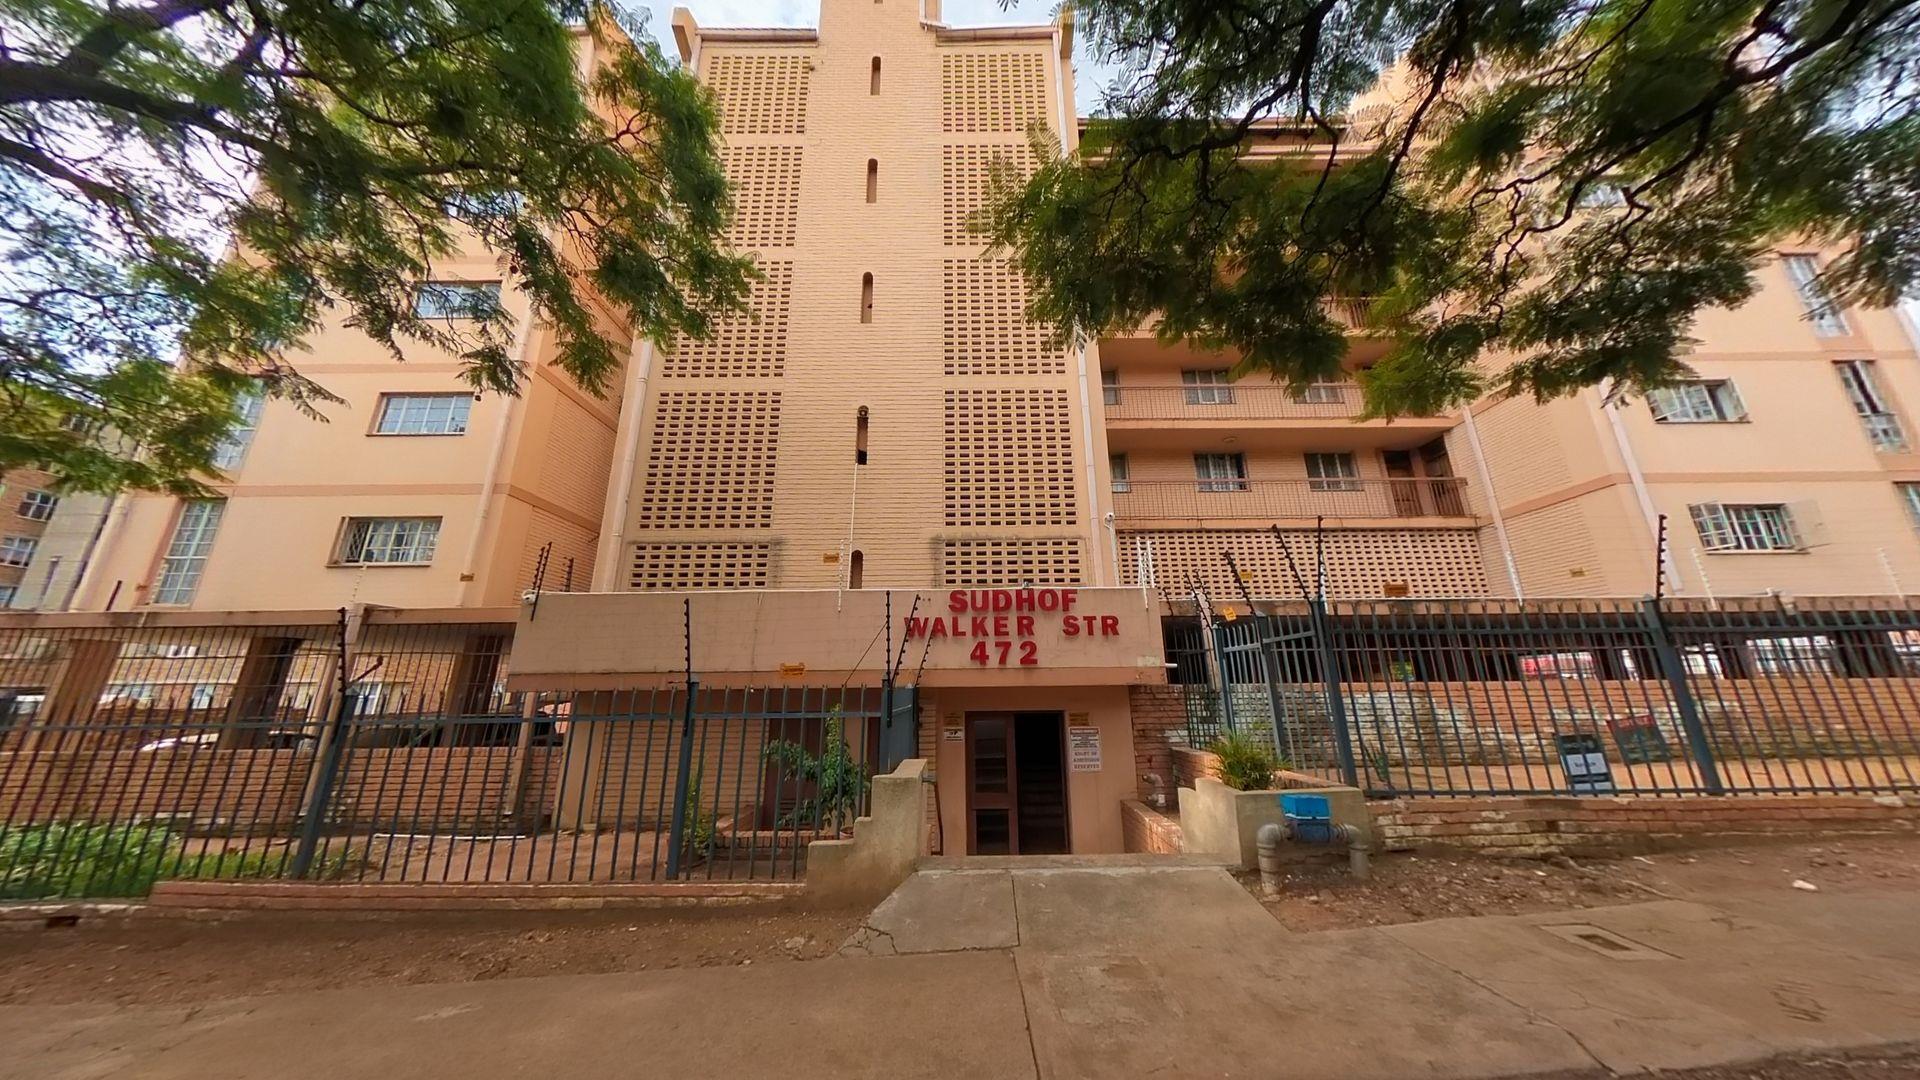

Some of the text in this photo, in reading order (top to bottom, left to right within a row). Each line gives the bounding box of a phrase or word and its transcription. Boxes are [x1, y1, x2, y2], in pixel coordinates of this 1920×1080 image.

[948, 589, 1078, 612] SUDHOF
[904, 616, 1120, 638] WALKER STR
[970, 641, 1038, 664] 472
